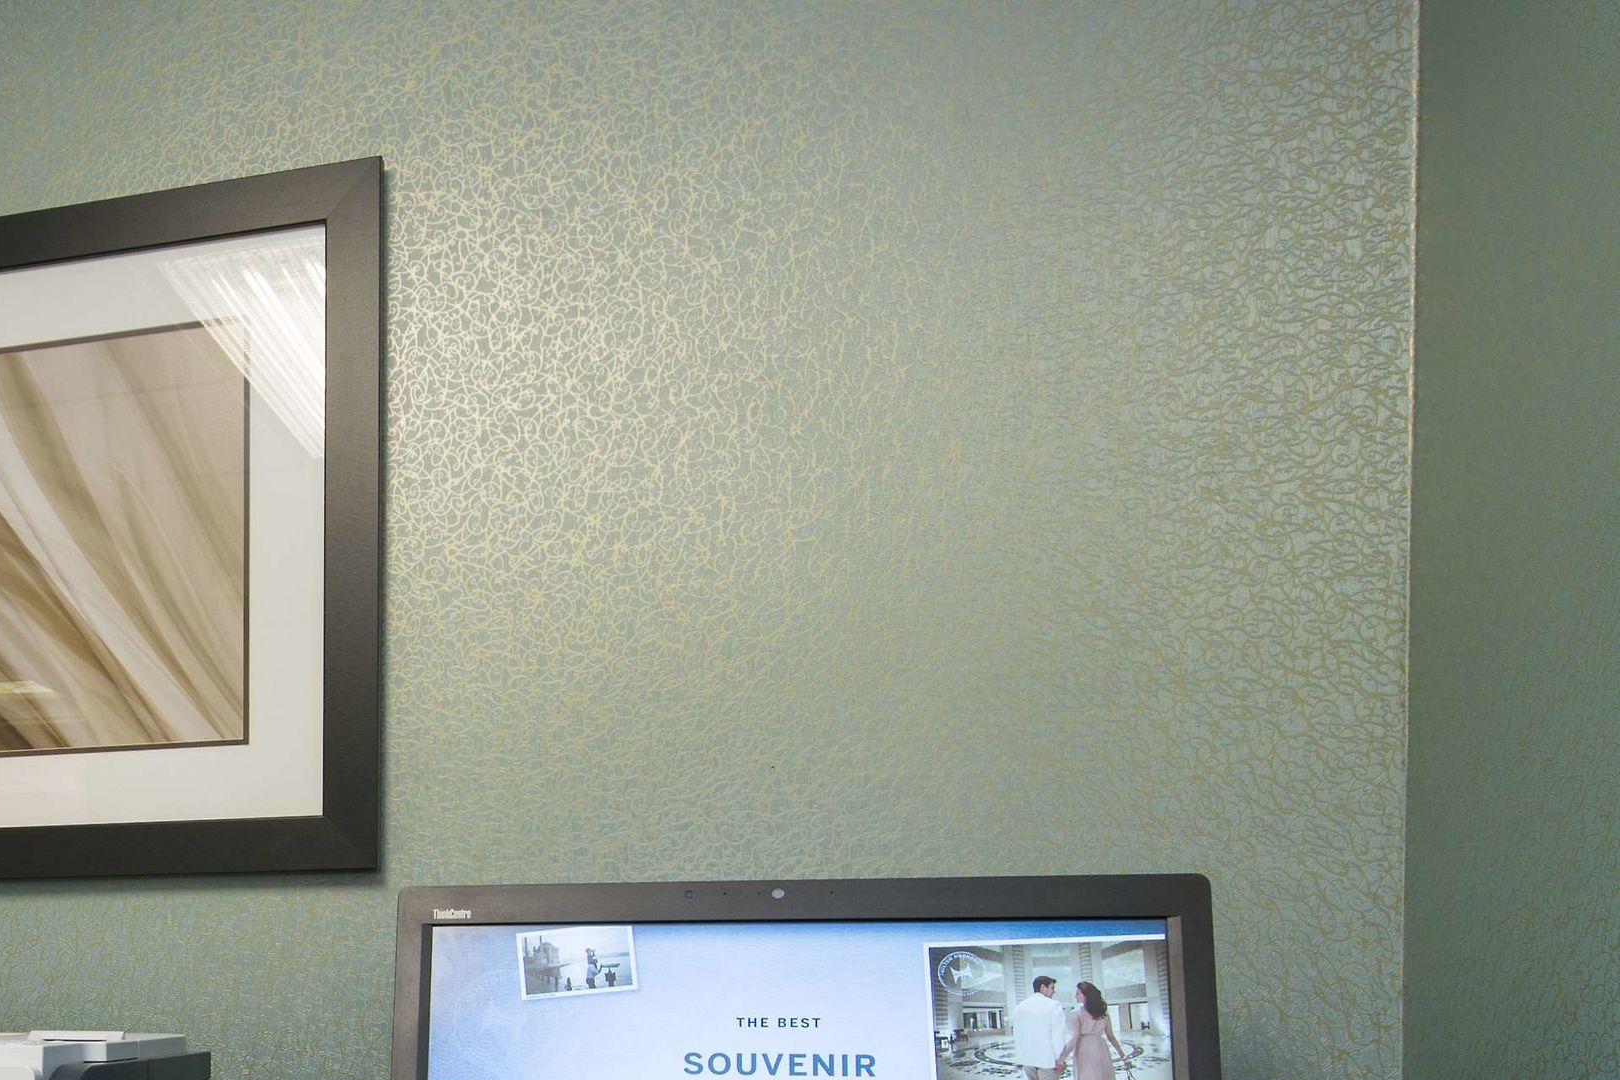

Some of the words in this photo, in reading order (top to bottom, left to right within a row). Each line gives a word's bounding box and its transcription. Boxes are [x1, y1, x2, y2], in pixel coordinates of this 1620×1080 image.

[736, 1017, 769, 1028] THE
[778, 1017, 821, 1028] BEST
[683, 1051, 876, 1077] SOUVENIR
